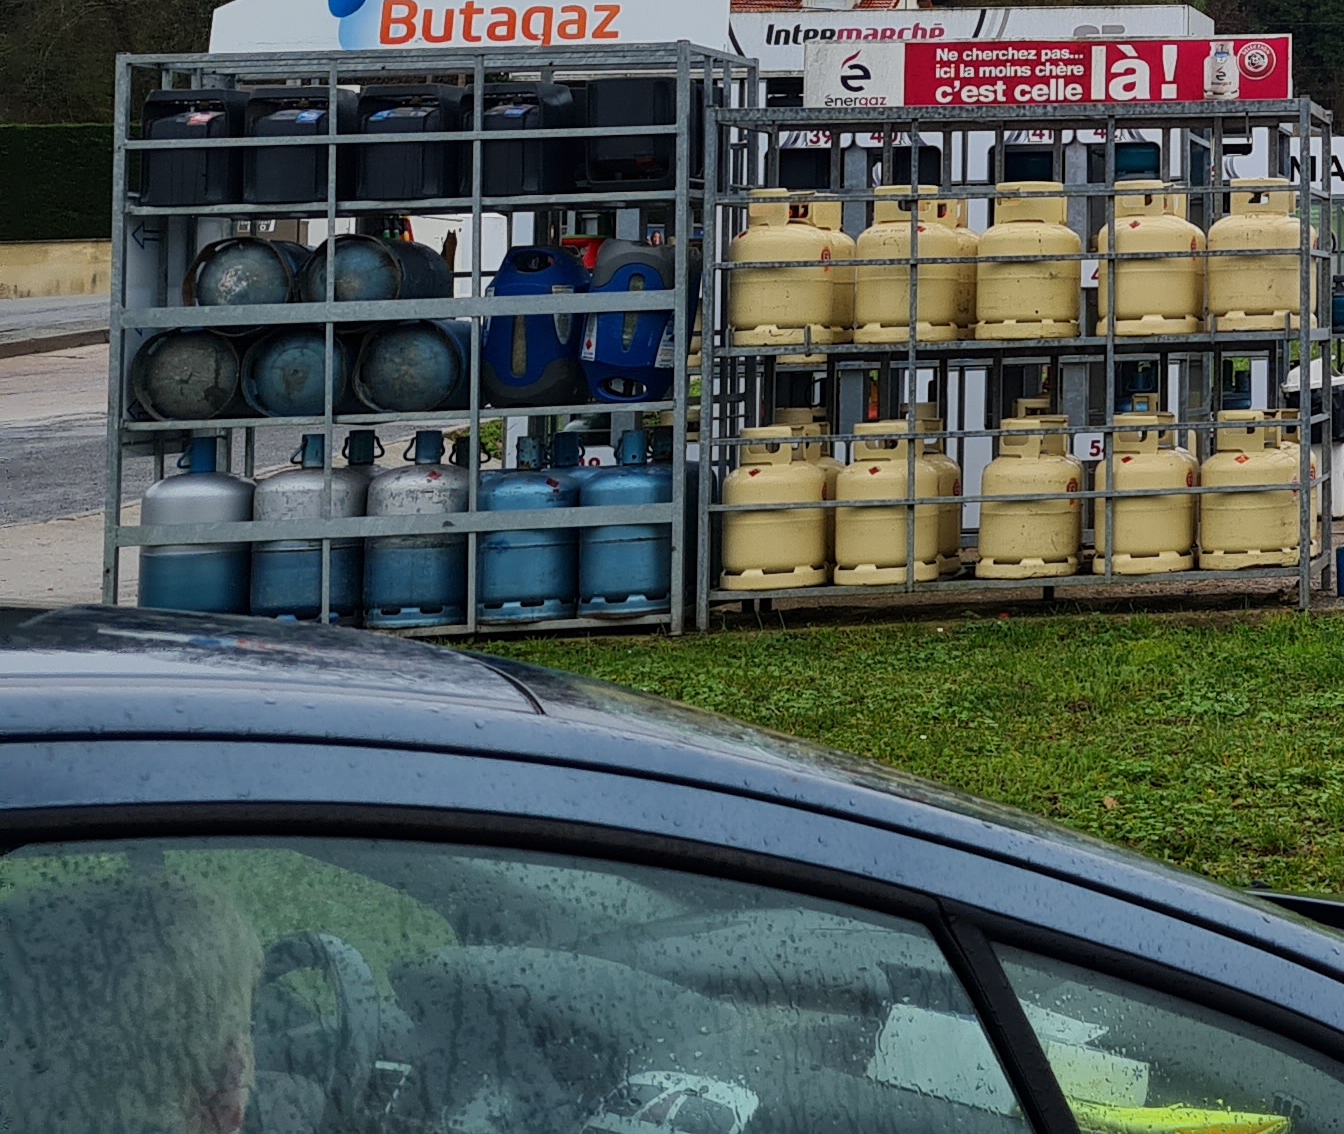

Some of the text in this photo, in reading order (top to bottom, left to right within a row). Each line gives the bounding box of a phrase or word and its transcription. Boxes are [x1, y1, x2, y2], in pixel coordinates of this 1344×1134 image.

[936, 47, 1084, 62] Ne cherchez pas...
[935, 62, 1084, 79] ici la moins chère
[935, 78, 1083, 103] c'est celle
